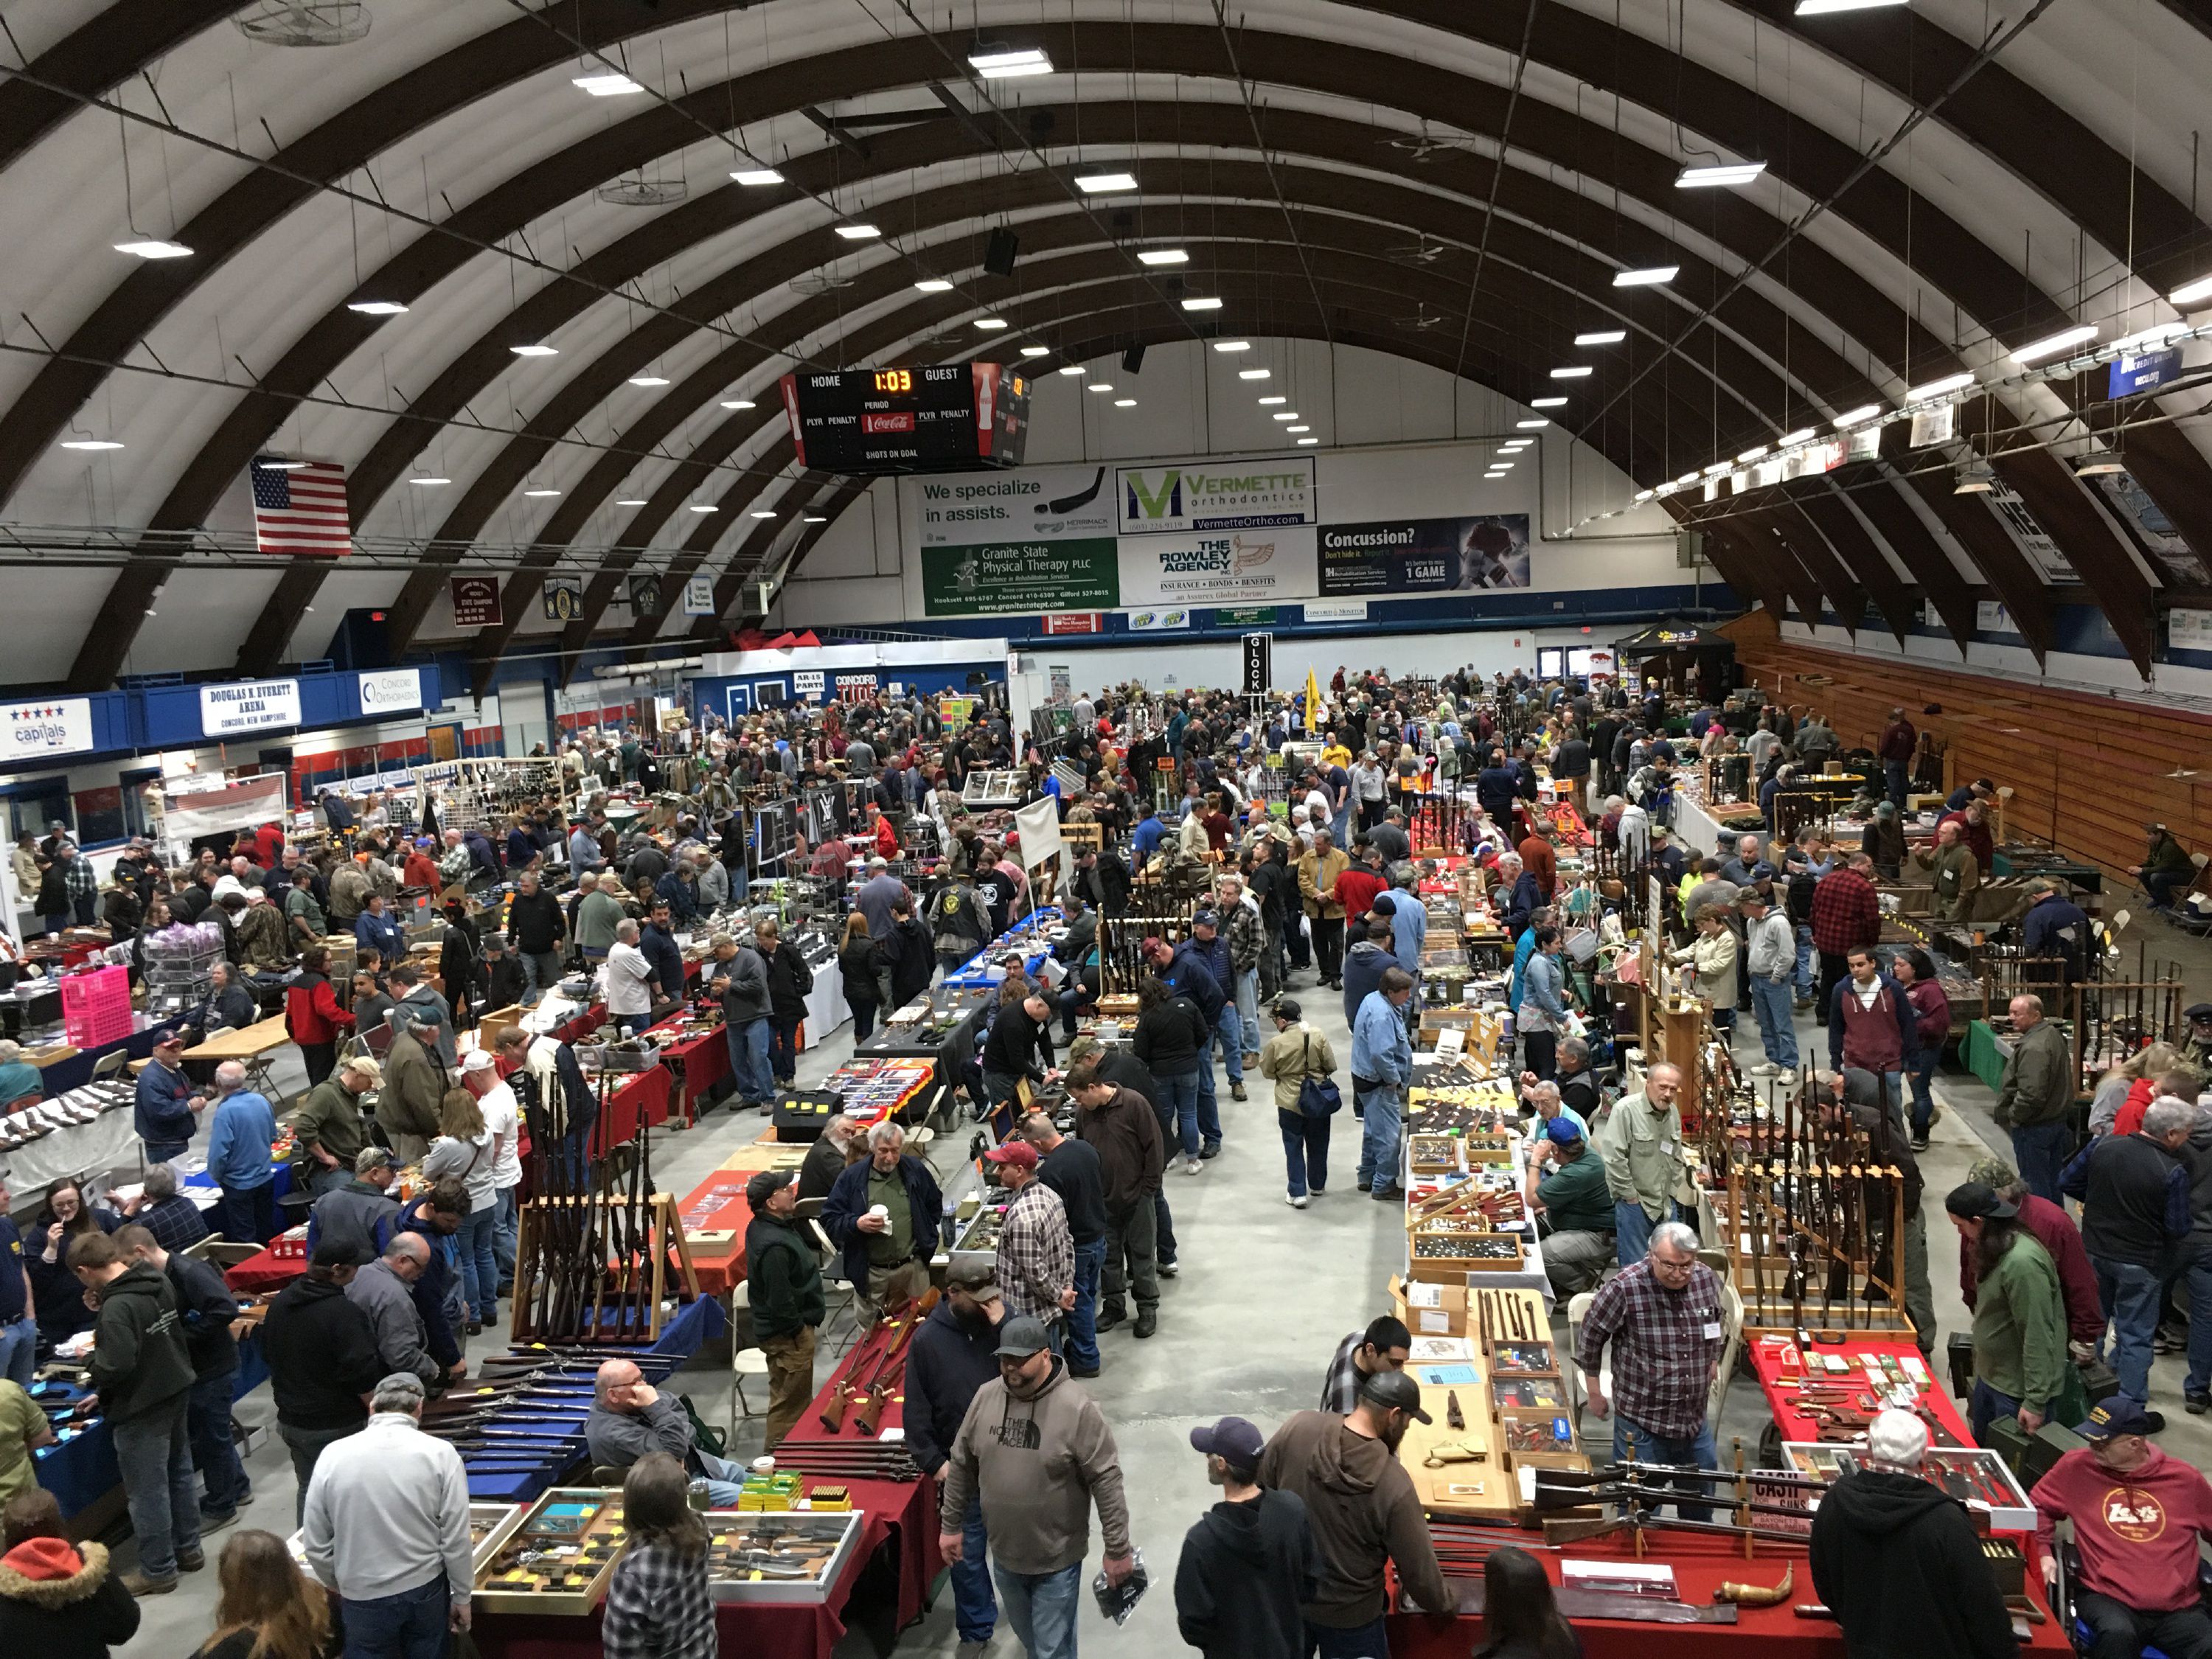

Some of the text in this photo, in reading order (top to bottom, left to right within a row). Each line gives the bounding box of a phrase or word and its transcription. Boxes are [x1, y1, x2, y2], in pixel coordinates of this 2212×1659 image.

[925, 368, 959, 381] GUEST
[811, 375, 841, 388] HOME
[875, 371, 911, 392] 1:03
[864, 400, 889, 410] PERIOD
[807, 416, 857, 426] PLYR PENALTY
[919, 409, 970, 420] PLYR PENALTY
[866, 448, 918, 460] SHOTS ON GOAL
[923, 479, 1041, 501] We specialize
[1191, 493, 1304, 507] orthodontics
[925, 505, 1010, 523] in assists.
[1129, 522, 1148, 532] (603)
[1197, 515, 1298, 530] VermetteOrtho.com
[1325, 528, 1415, 548] Concussion?
[1197, 539, 1230, 551] THE
[981, 546, 1048, 560] Granite State
[1159, 550, 1231, 563] ROWLEY
[1341, 550, 1354, 558] hide
[983, 559, 1091, 575] Physical Therapy PLLC
[1163, 560, 1231, 573] AGENCY
[1406, 566, 1446, 578] 1 GAME
[1161, 577, 1276, 591] INSURANCE BONDS BENEFITS
[1240, 590, 1267, 598] Partner
[978, 601, 1065, 612] www.granitestatept.com
[1251, 637, 1260, 689] GLOCK
[381, 678, 411, 689] CONCORD
[796, 681, 824, 689] PARTS
[835, 674, 877, 686] CONCORD
[210, 688, 246, 703] DOUGLAS
[257, 684, 291, 698] EVERETT
[376, 689, 420, 703] ORTHOPAEDICS
[836, 684, 879, 703] TIDE
[239, 700, 266, 713] ARENA
[247, 715, 259, 726] NEW
[260, 712, 287, 723] HAMPSHIRE
[15, 721, 66, 745] capitals
[1006, 1417, 1028, 1427] THE
[989, 1425, 1025, 1437] NORTH
[997, 1437, 1023, 1449] FACE
[1756, 1471, 1798, 1498] CASH
